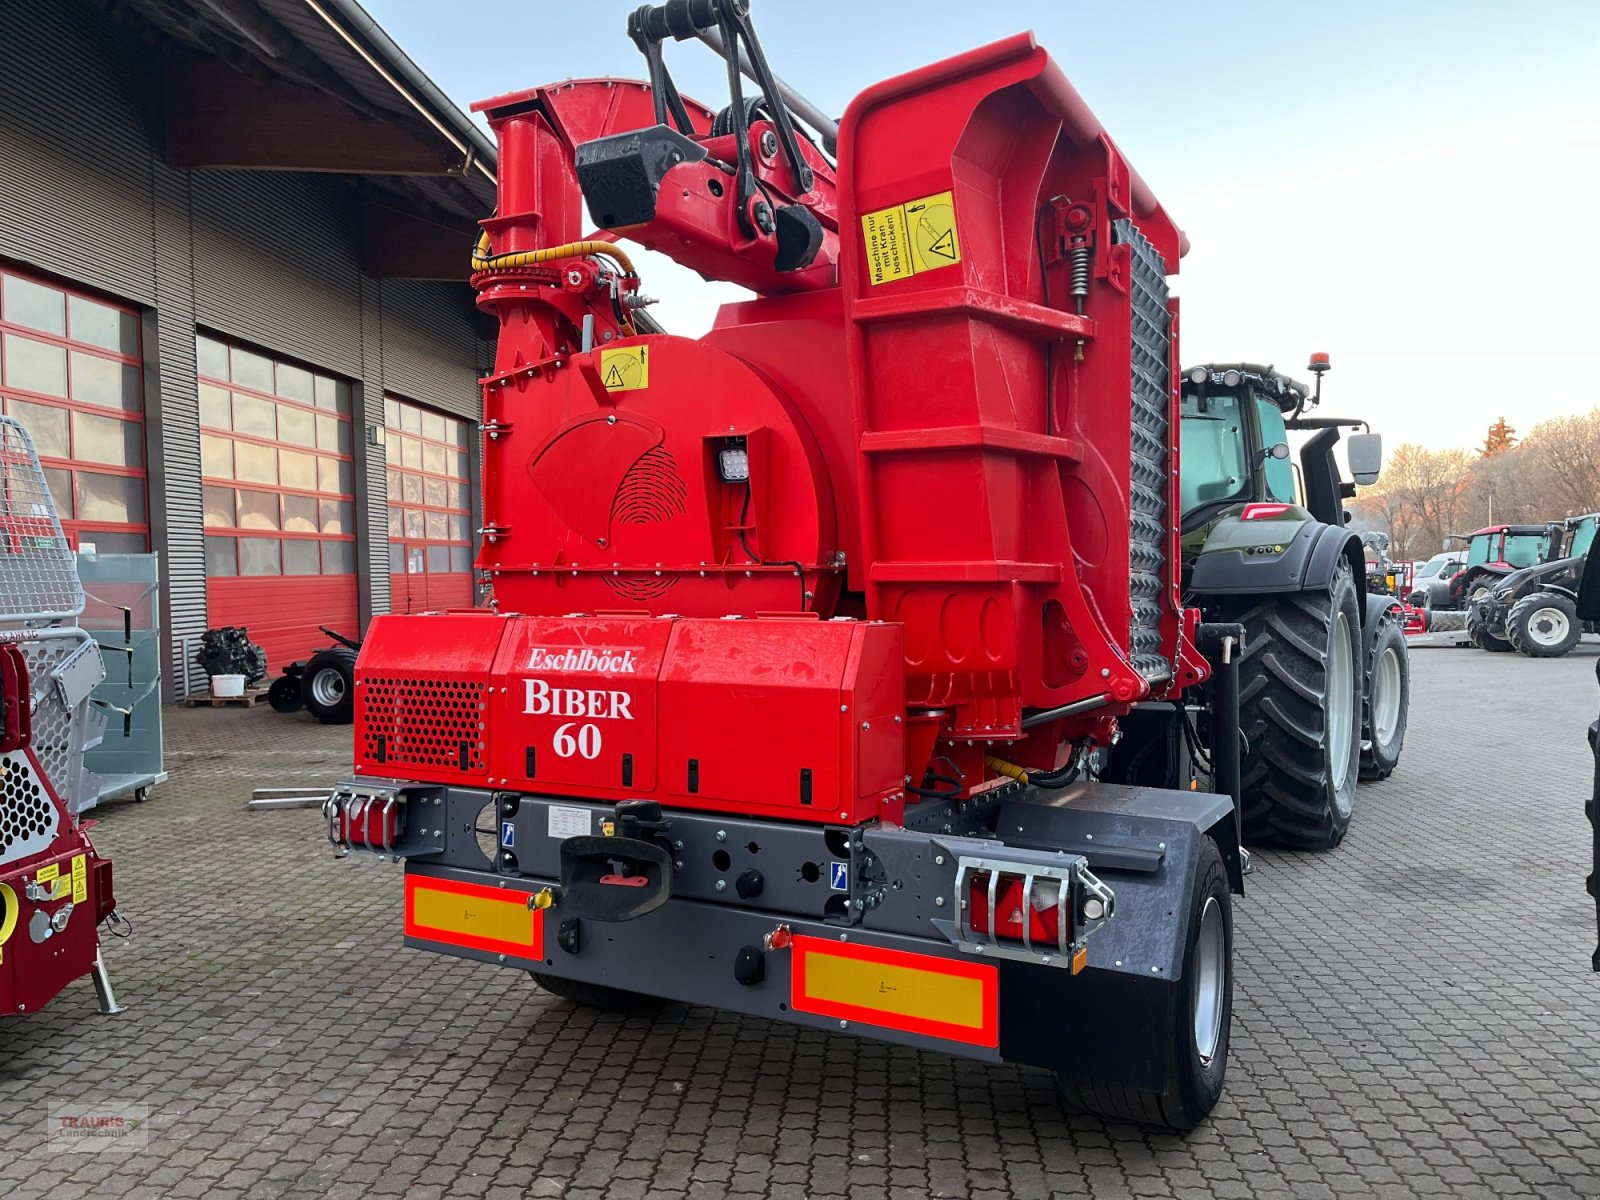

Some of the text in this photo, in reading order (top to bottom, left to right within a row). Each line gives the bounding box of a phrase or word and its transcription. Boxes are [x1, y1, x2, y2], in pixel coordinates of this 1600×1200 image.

[868, 216, 883, 282] Maschine nur
[880, 225, 890, 267] mit Kran
[885, 214, 900, 274] beschicken!
[527, 647, 638, 673] Eschlböck
[521, 678, 635, 720] BIBER
[552, 722, 603, 760] 60
